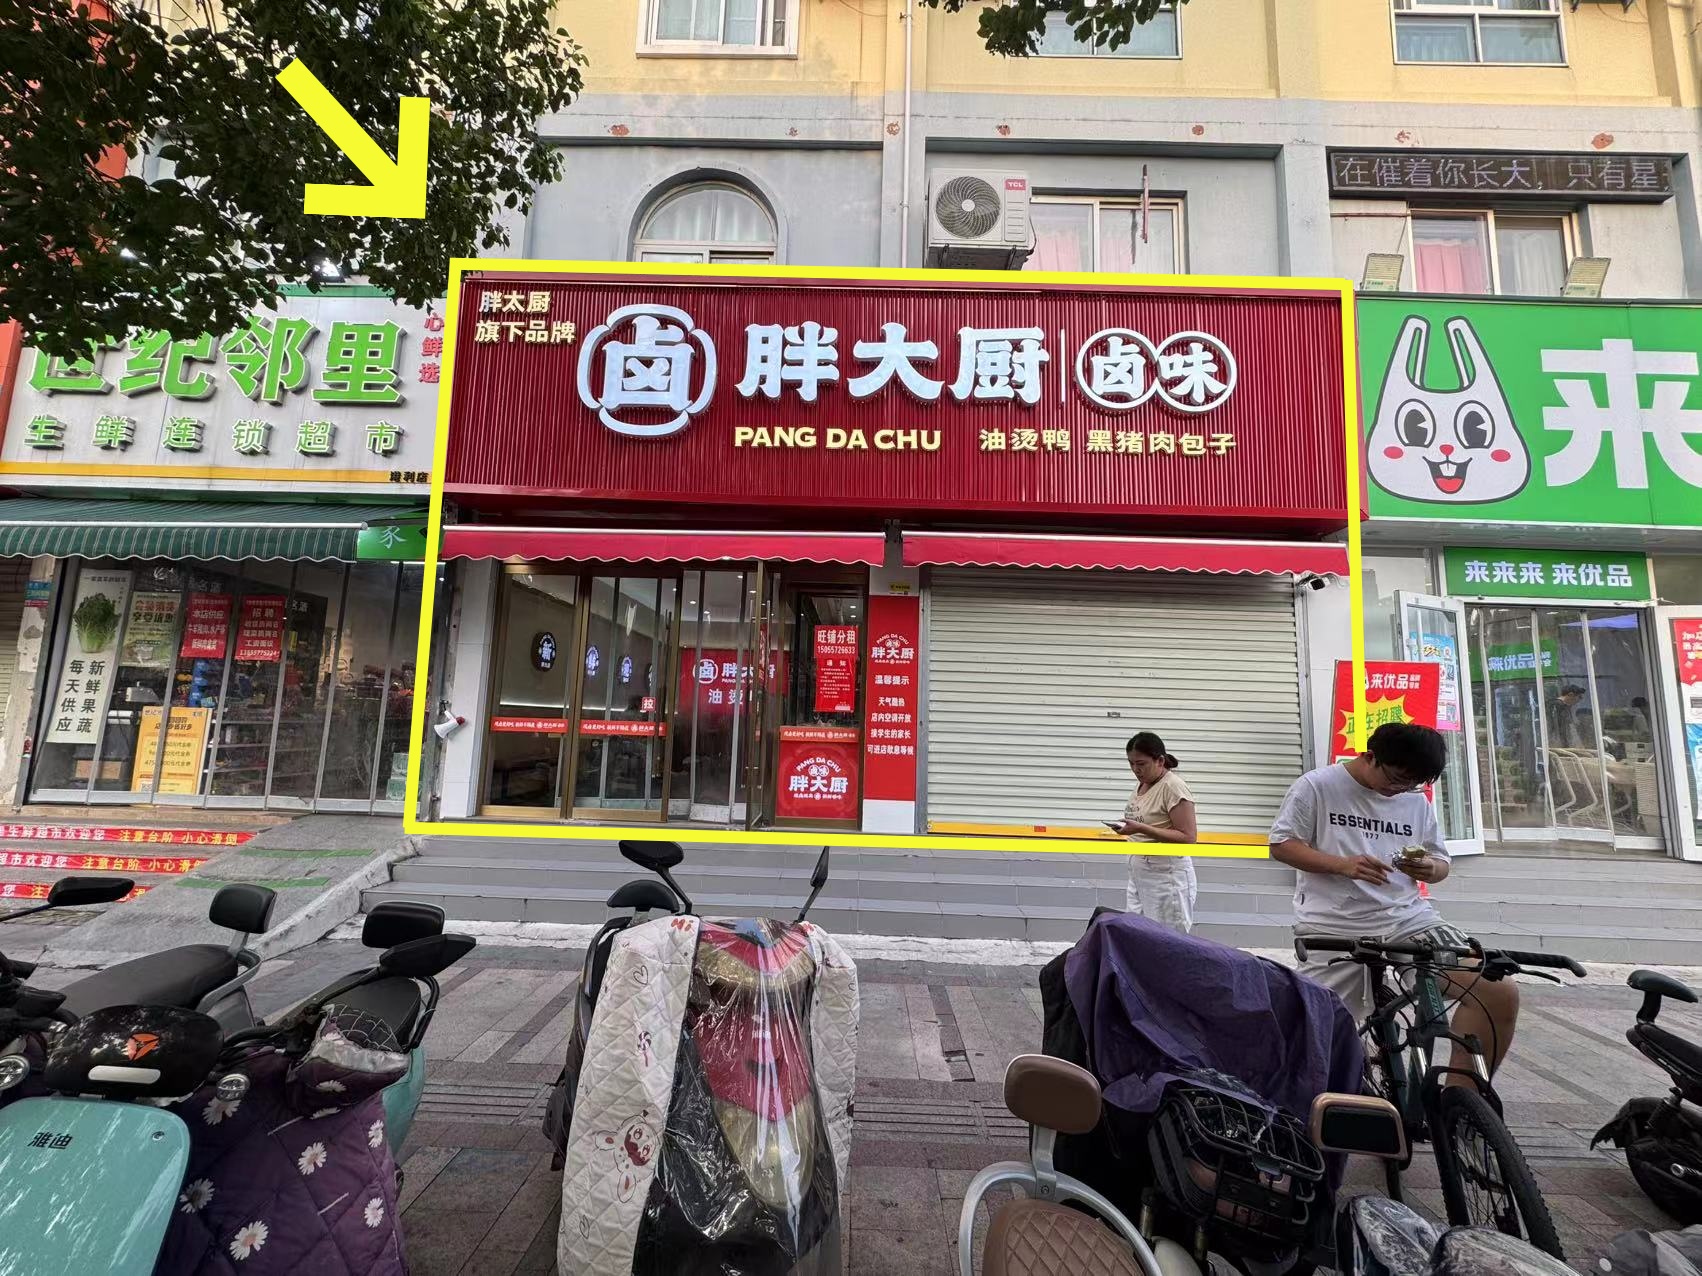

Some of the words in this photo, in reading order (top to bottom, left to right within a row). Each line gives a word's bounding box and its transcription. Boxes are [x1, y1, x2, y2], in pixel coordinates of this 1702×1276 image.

[478, 290, 551, 314] 胖太厨
[475, 320, 576, 343] 旗下品牌
[590, 310, 704, 418] 卤
[734, 320, 1051, 405] 胖大厨
[1088, 334, 1230, 404] 卤味
[1540, 338, 1702, 489] 来
[23, 414, 401, 456] 生鲜连锁超市
[734, 426, 817, 447] PANG
[825, 428, 869, 449] DA
[873, 429, 942, 450] CHU
[979, 428, 1071, 452] 油烫鸭
[1086, 430, 1237, 456] 黑猪肉包子
[1465, 560, 1545, 585] 来来来
[1552, 562, 1633, 588] 来优品
[817, 629, 856, 644] 旺铺分租
[898, 635, 910, 645] CHU
[871, 646, 915, 660] 胖大厨
[875, 674, 910, 686] 温馨提示
[1371, 673, 1409, 690] 来优品
[55, 659, 85, 732] 每天供应
[76, 660, 106, 733] 新鲜果蔬
[870, 712, 912, 723] 店内空调开放
[870, 728, 912, 739] 接学生的家长
[796, 757, 815, 772] PANG
[826, 759, 842, 773] CHU
[788, 775, 849, 794] 胖大厨
[1329, 812, 1413, 837] ESSENTIALS
[120, 829, 174, 843] 注意台阶
[181, 833, 239, 846] 小心滑倒
[81, 856, 141, 871] 注意台阶
[27, 1131, 73, 1150] 雅迪
